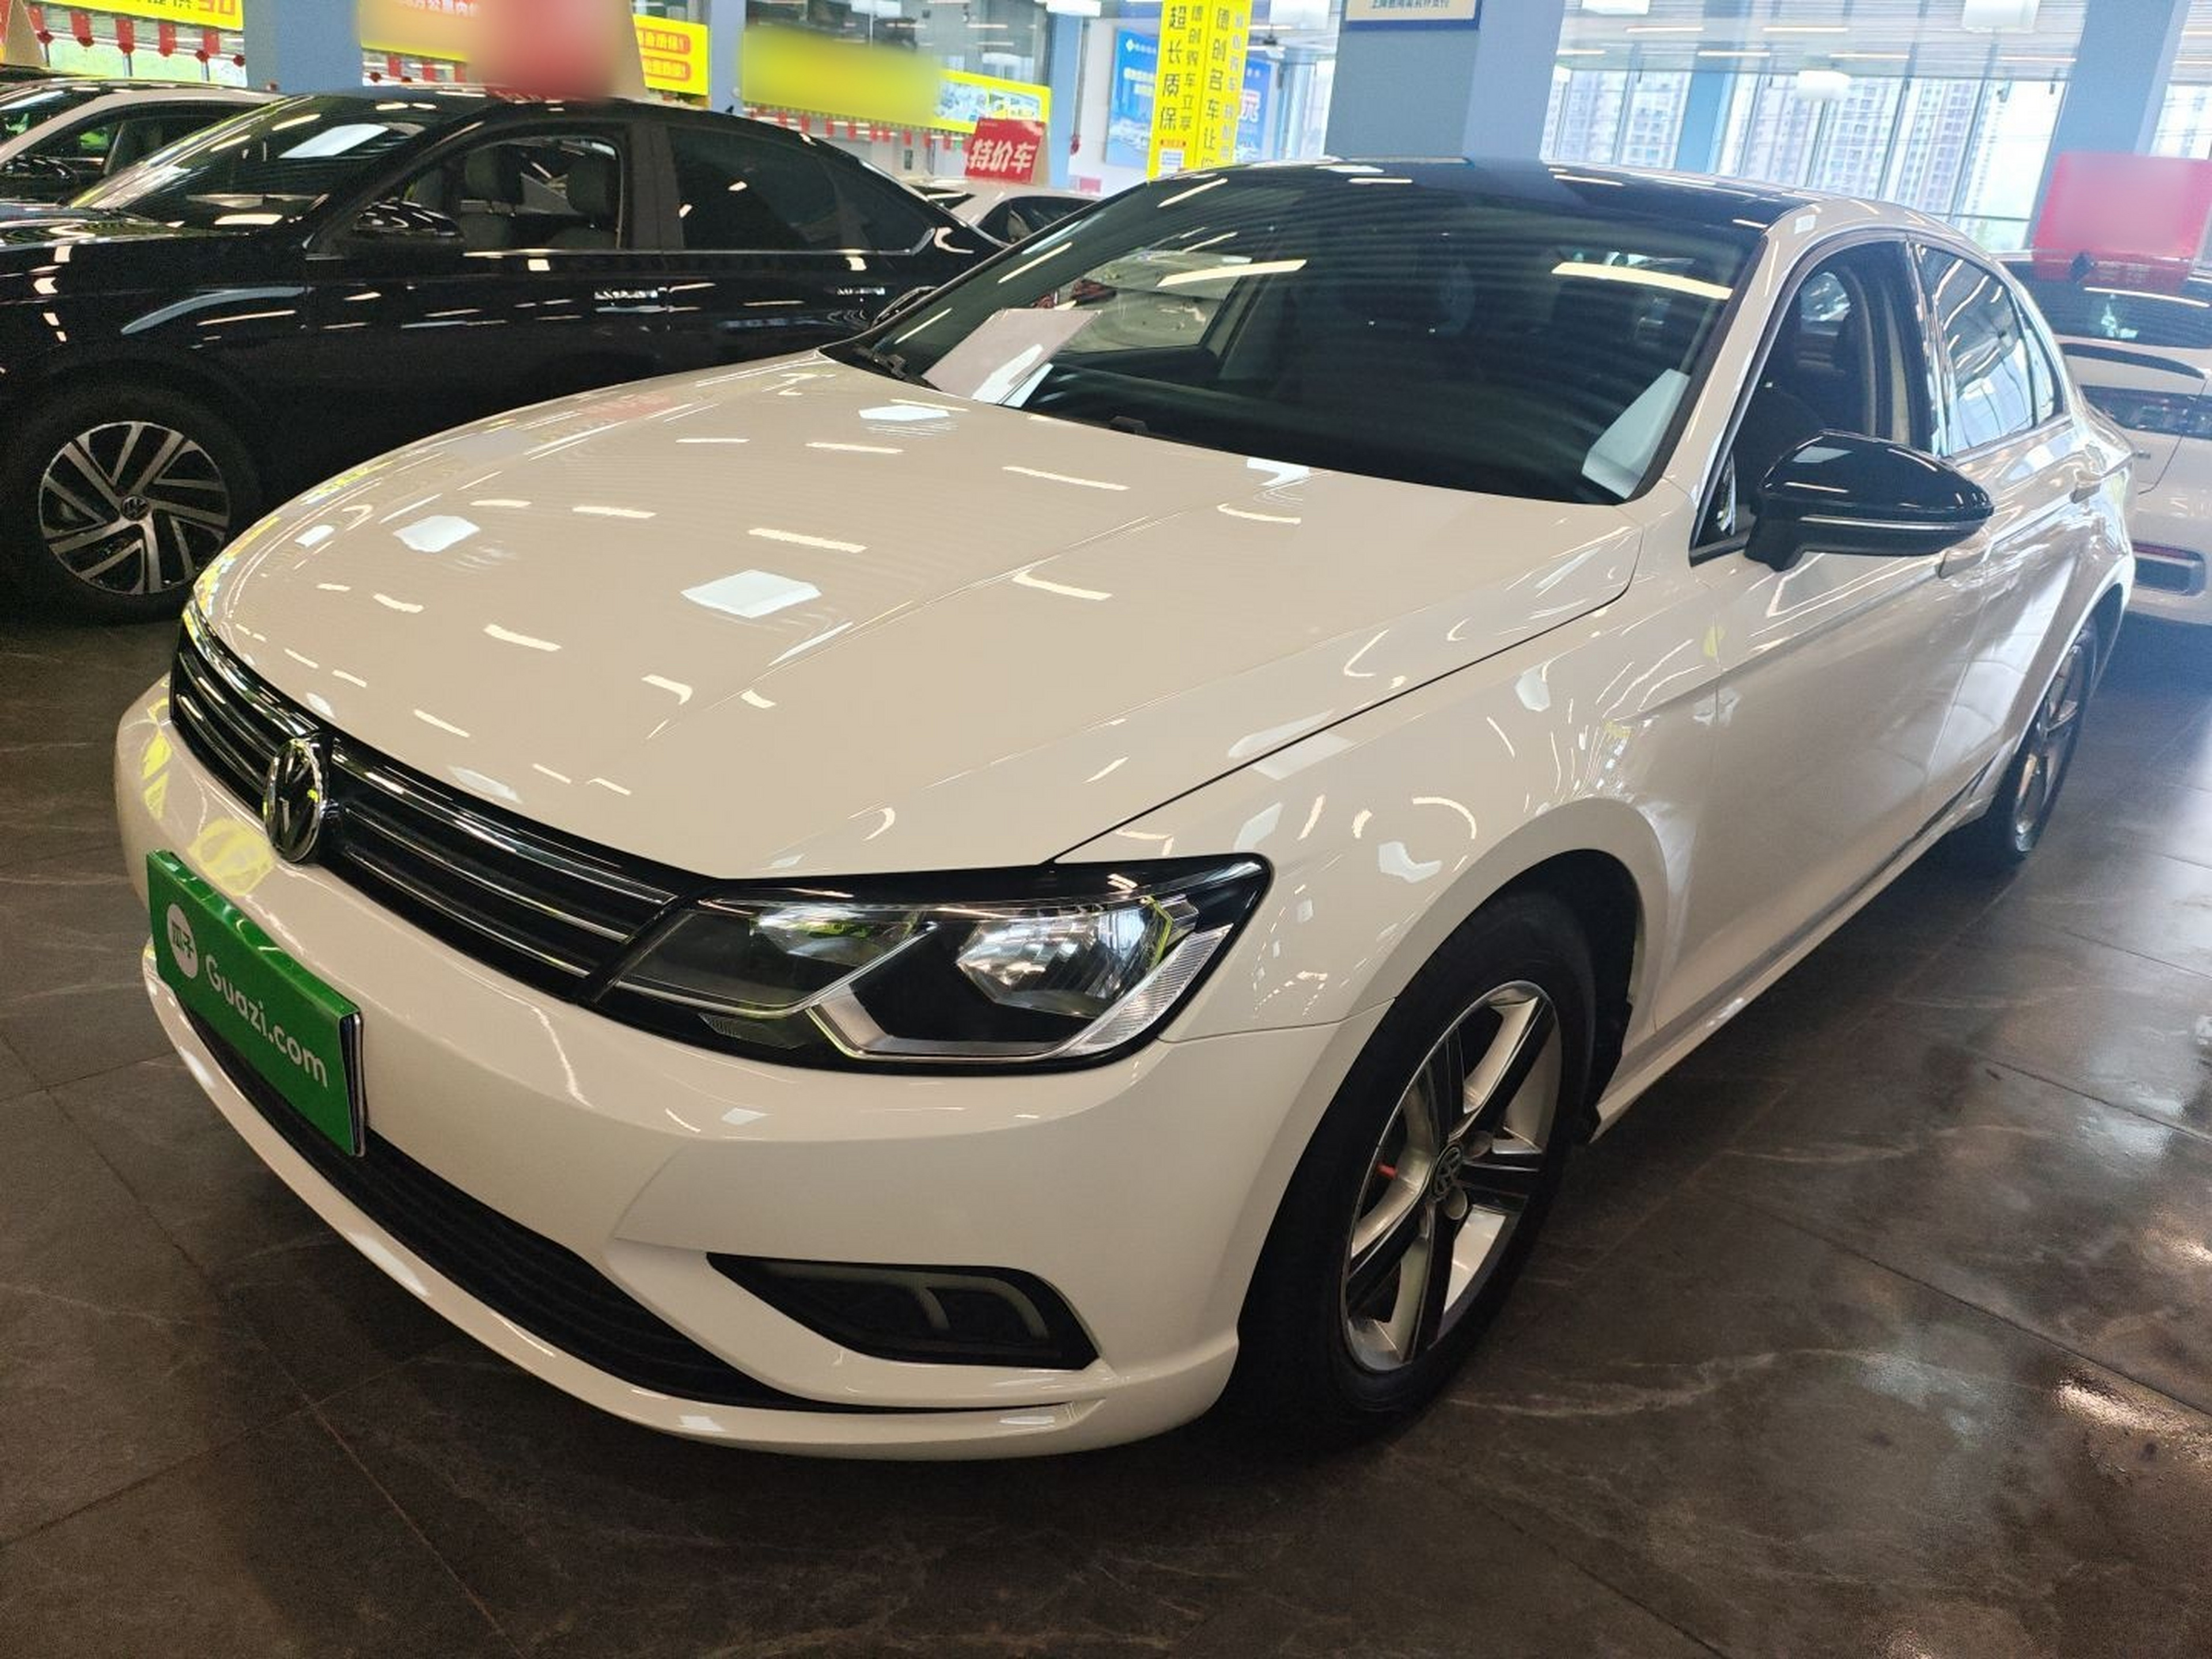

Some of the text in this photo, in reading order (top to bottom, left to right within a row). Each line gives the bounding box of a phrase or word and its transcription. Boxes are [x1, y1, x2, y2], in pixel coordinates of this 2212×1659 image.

[1159, 5, 1187, 130] 超长质保
[968, 138, 1037, 174] 特价车
[205, 955, 328, 1088] Guazi.com
